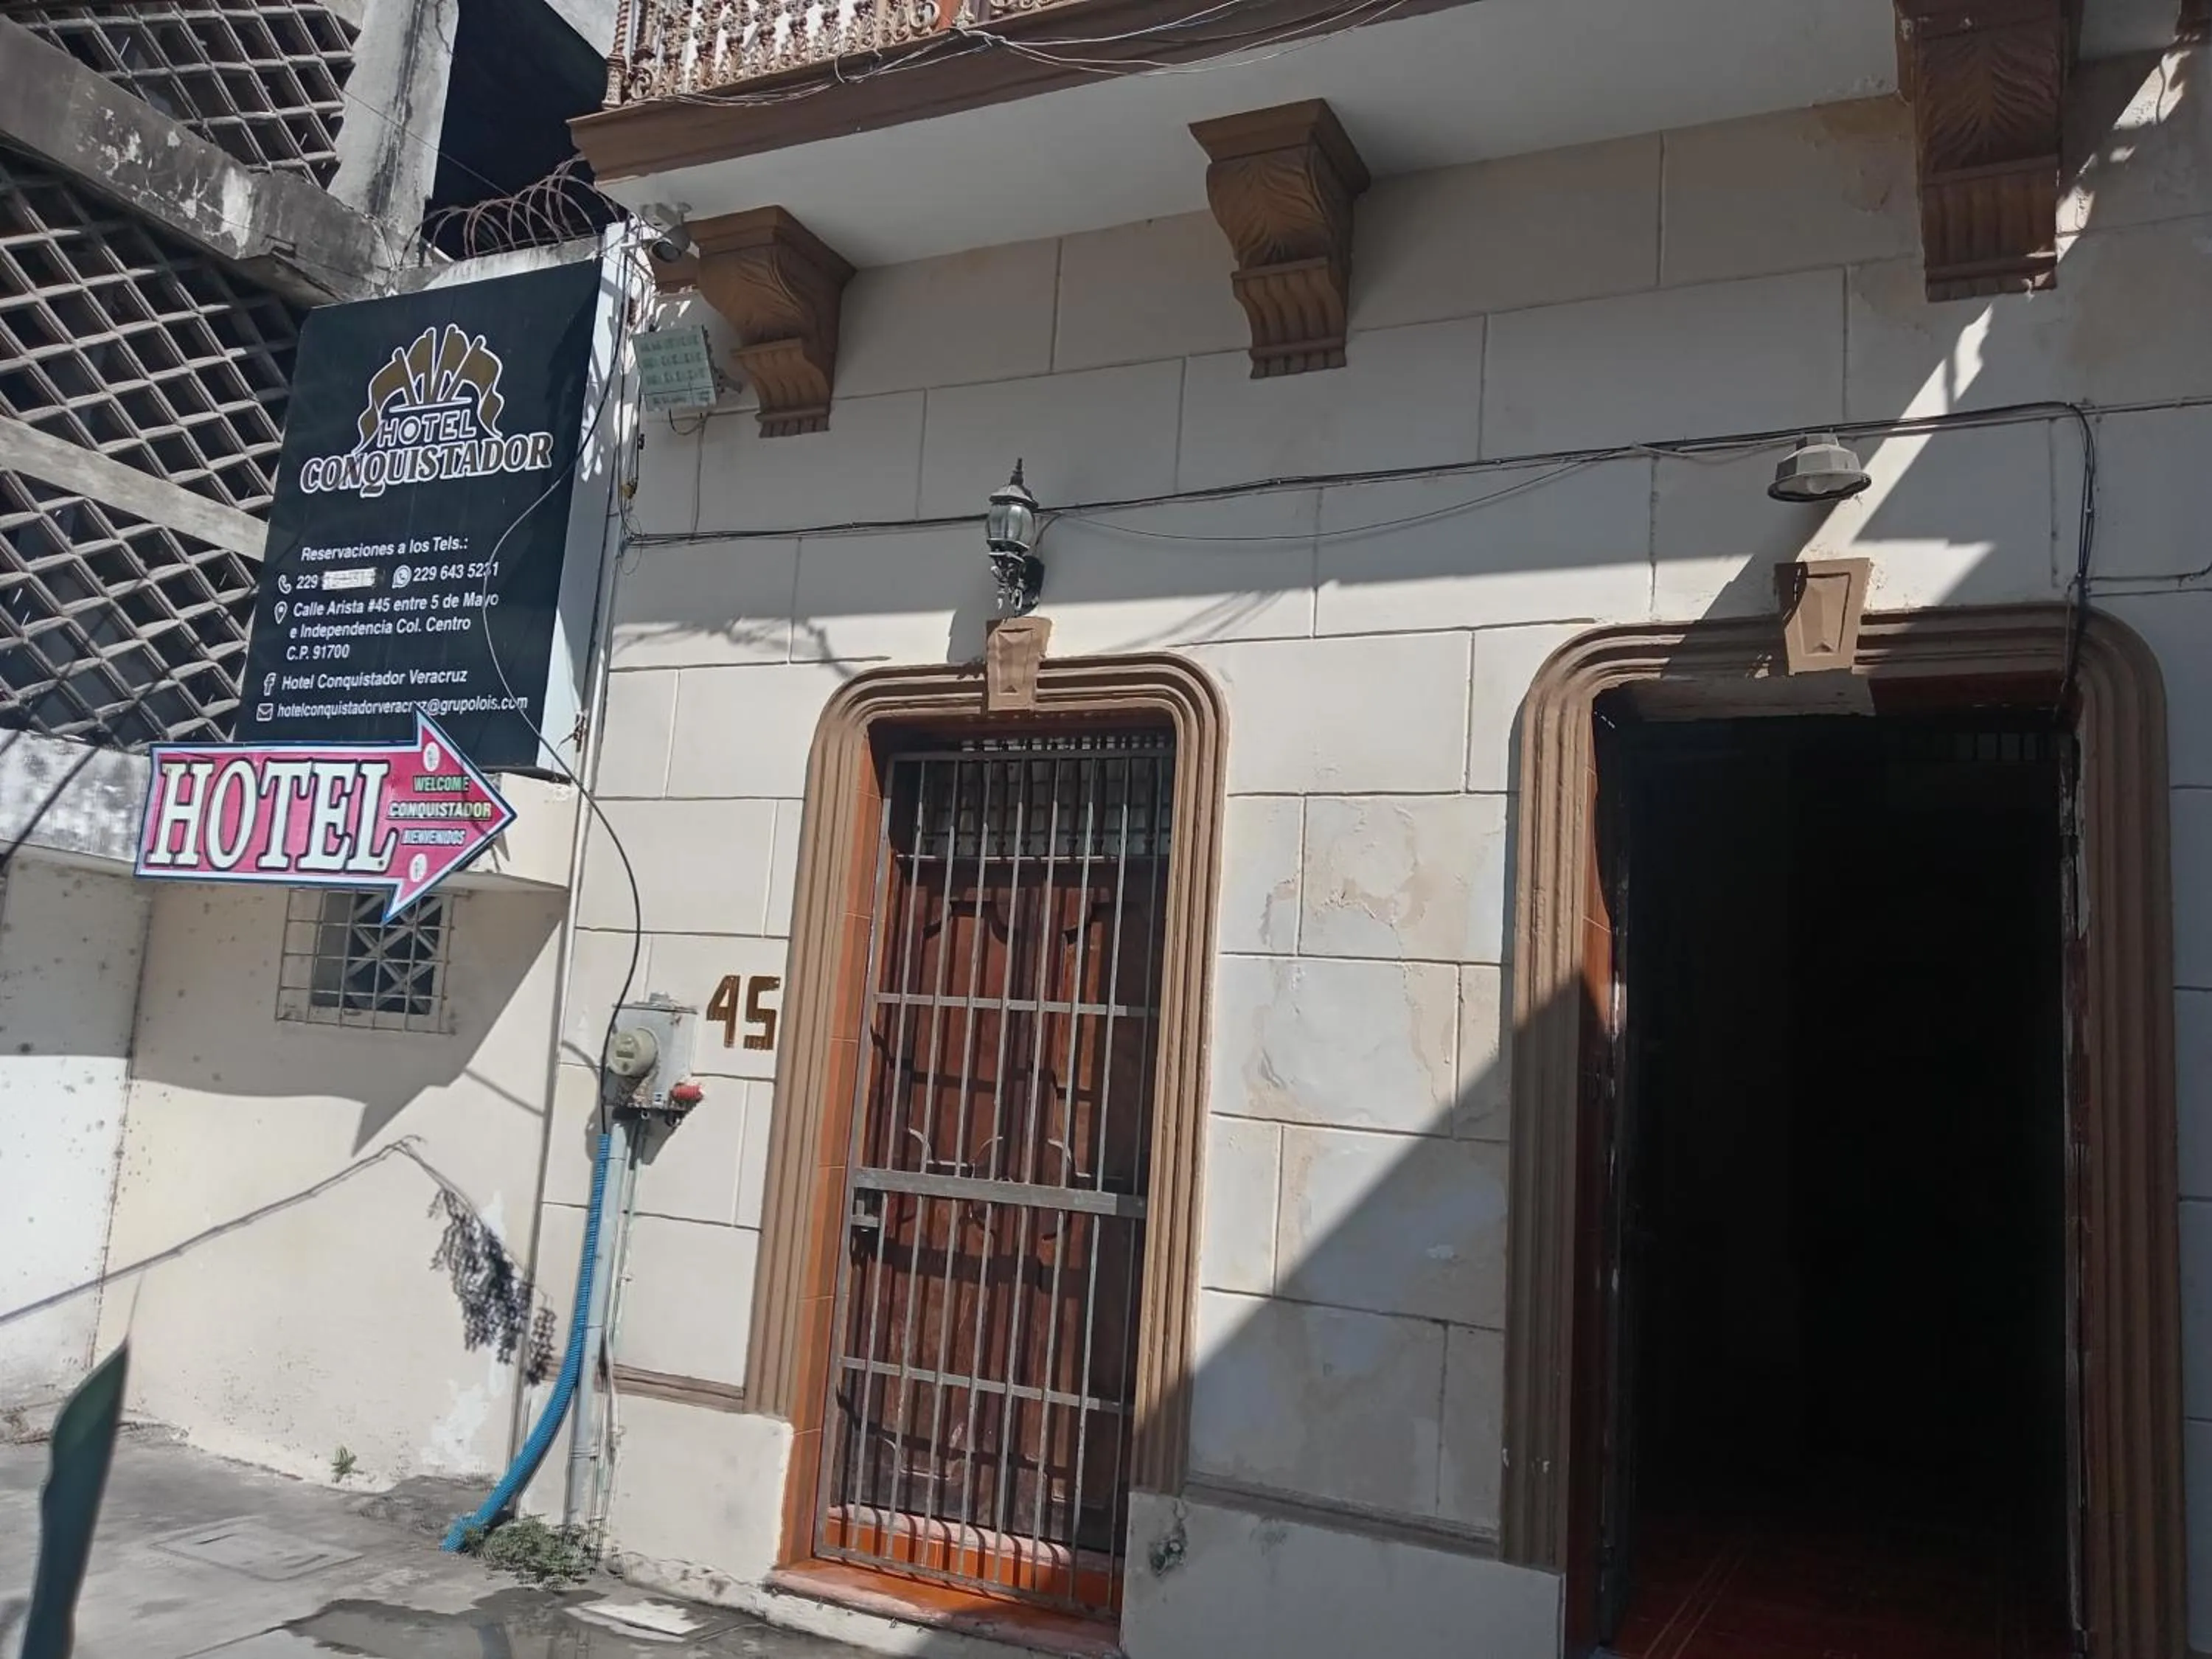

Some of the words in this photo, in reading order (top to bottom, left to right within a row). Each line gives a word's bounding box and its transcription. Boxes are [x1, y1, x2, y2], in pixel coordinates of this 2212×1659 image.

[378, 408, 477, 448] HOTEL
[300, 431, 554, 498] CONQUISTADOR
[302, 543, 394, 561] Reservaciones
[397, 543, 406, 554] a
[409, 538, 430, 553] los
[434, 536, 469, 552] Tels.:
[296, 574, 318, 589] 229
[413, 566, 437, 582] 229
[441, 564, 464, 580] 643
[293, 601, 324, 617] Calle
[327, 599, 364, 616] Arista
[369, 597, 390, 613] #45
[393, 597, 426, 612] entre
[430, 594, 439, 609] 5
[442, 593, 459, 608] de
[463, 592, 498, 611] Mayo
[289, 627, 296, 639] e
[300, 620, 392, 640] Independencia
[395, 618, 421, 634] Col.
[425, 616, 471, 632] Centro
[286, 645, 309, 661] C.P.
[313, 644, 349, 659] 91700
[282, 675, 313, 691] Hotel
[317, 669, 406, 690] Conquistador
[409, 668, 467, 686] Veracruz
[277, 694, 528, 717] hotelconquistadorveracrz@grupolois.com
[414, 776, 470, 793] WELCOME
[145, 757, 399, 873] HOTEL
[387, 801, 492, 821] CONQUISTADOR
[706, 974, 781, 1051] 45
